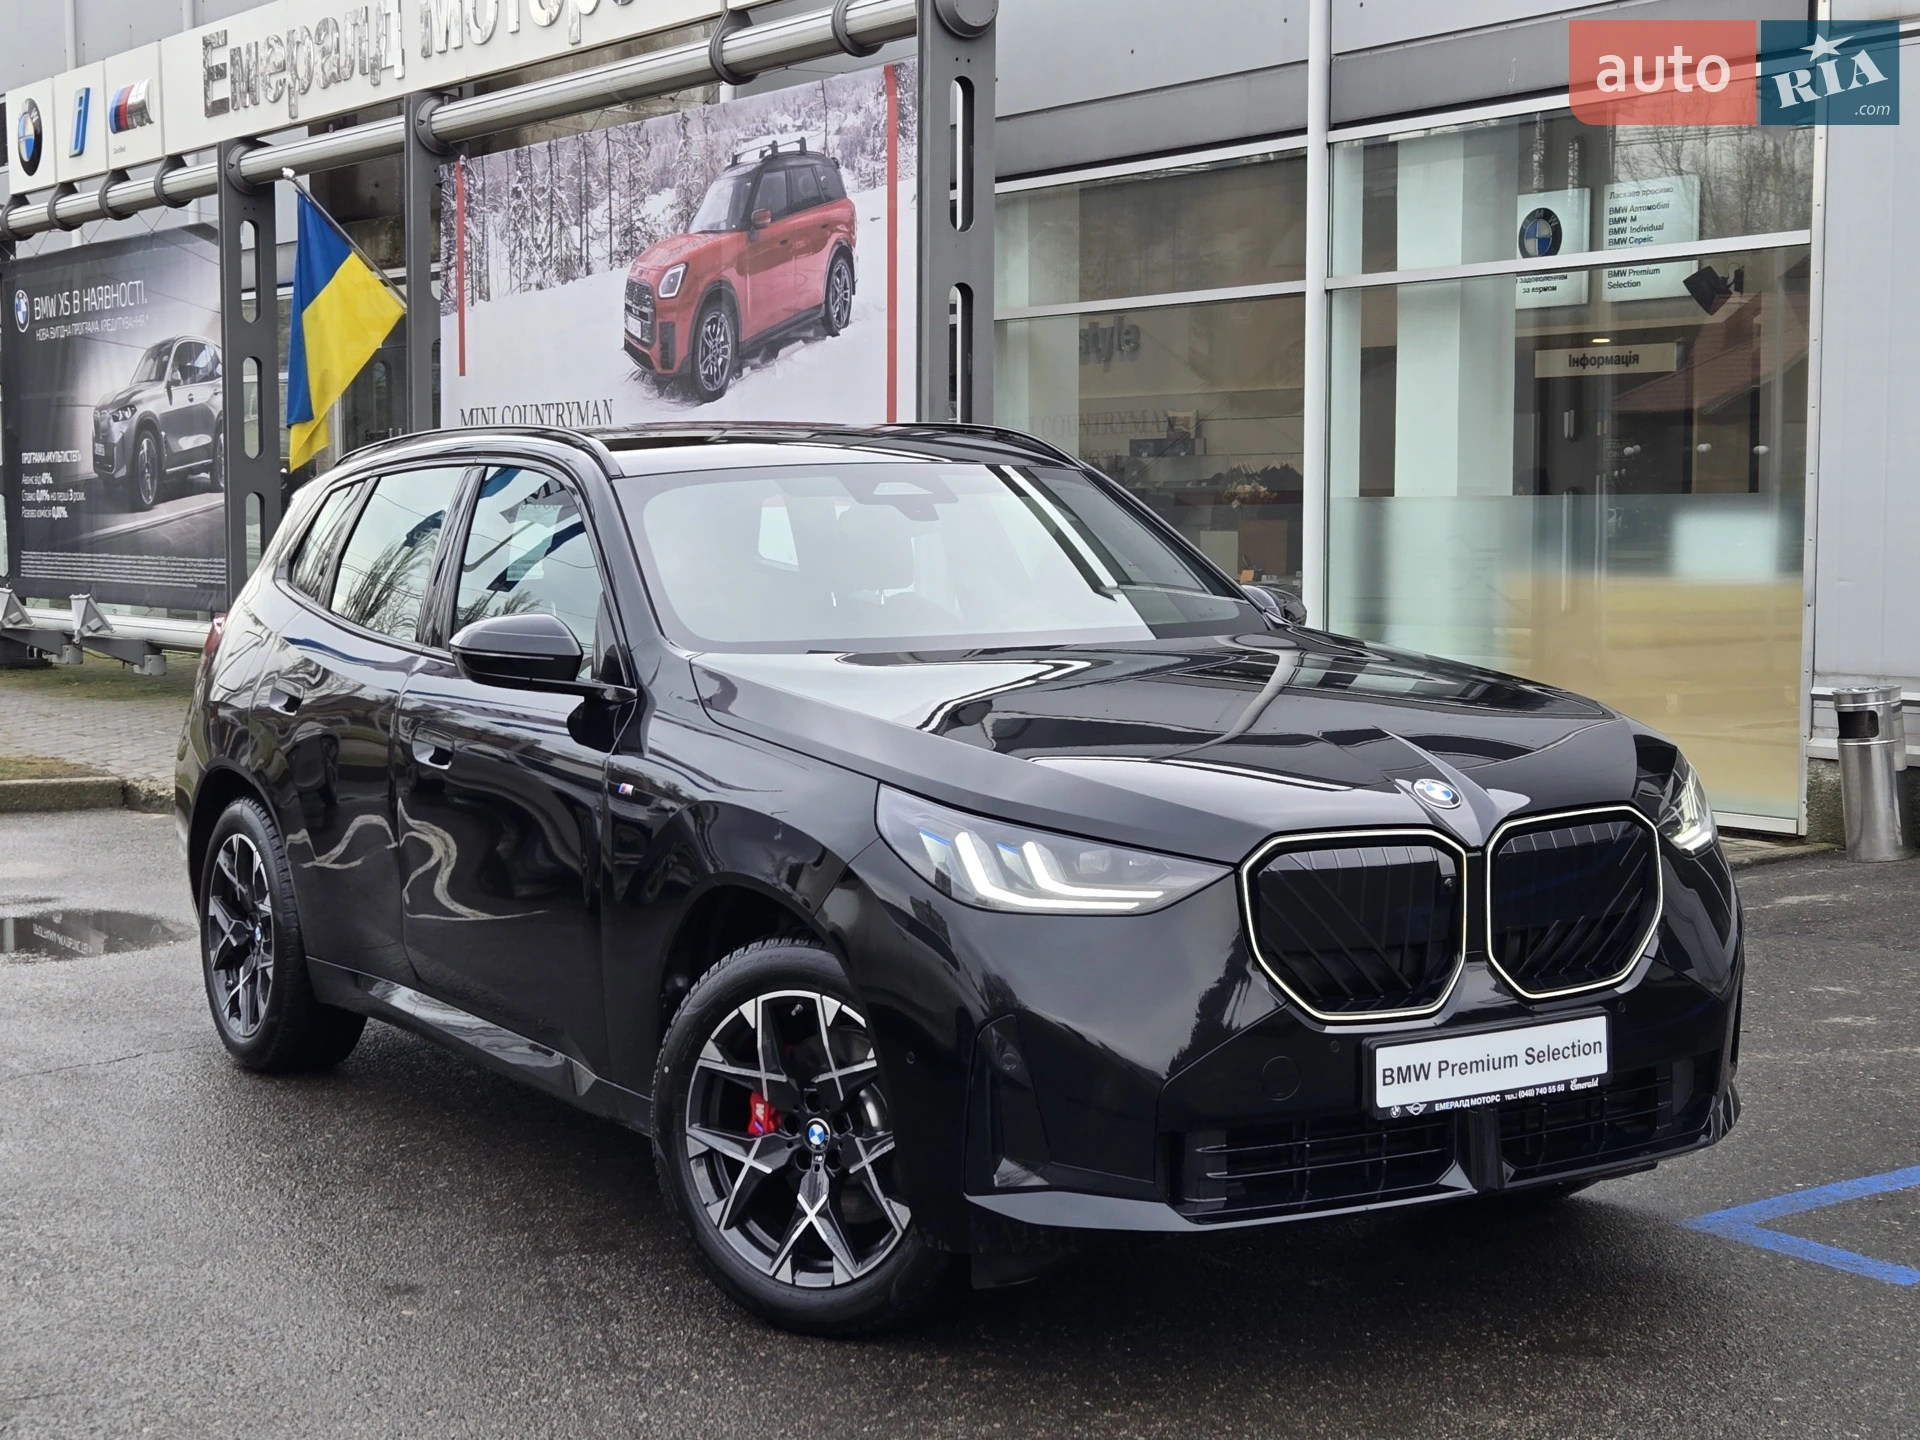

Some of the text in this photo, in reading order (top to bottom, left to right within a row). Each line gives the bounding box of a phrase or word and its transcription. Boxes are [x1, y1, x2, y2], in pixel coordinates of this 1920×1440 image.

[1641, 186, 1674, 197] просимо
[1609, 201, 1670, 215] BMW Автомобілі
[1608, 216, 1628, 226] BMW
[1608, 222, 1664, 236] BMW Individual
[1608, 234, 1654, 246] BMW Сервіс
[1607, 267, 1661, 278] BMW Premium
[1607, 280, 1641, 289] Selection
[34, 294, 56, 320] BMW
[58, 292, 70, 316] X5
[83, 280, 147, 312] НАЯВНОСТІ.
[1568, 350, 1640, 370] Інформація
[460, 398, 613, 427] MINI COUNTRYMAN
[1381, 1039, 1603, 1087] BMW Premium Selection
[1570, 1077, 1599, 1091] Emerald
[1434, 1099, 1470, 1112] ЕМЕРАЛД
[1471, 1094, 1501, 1106] МОТОРС
